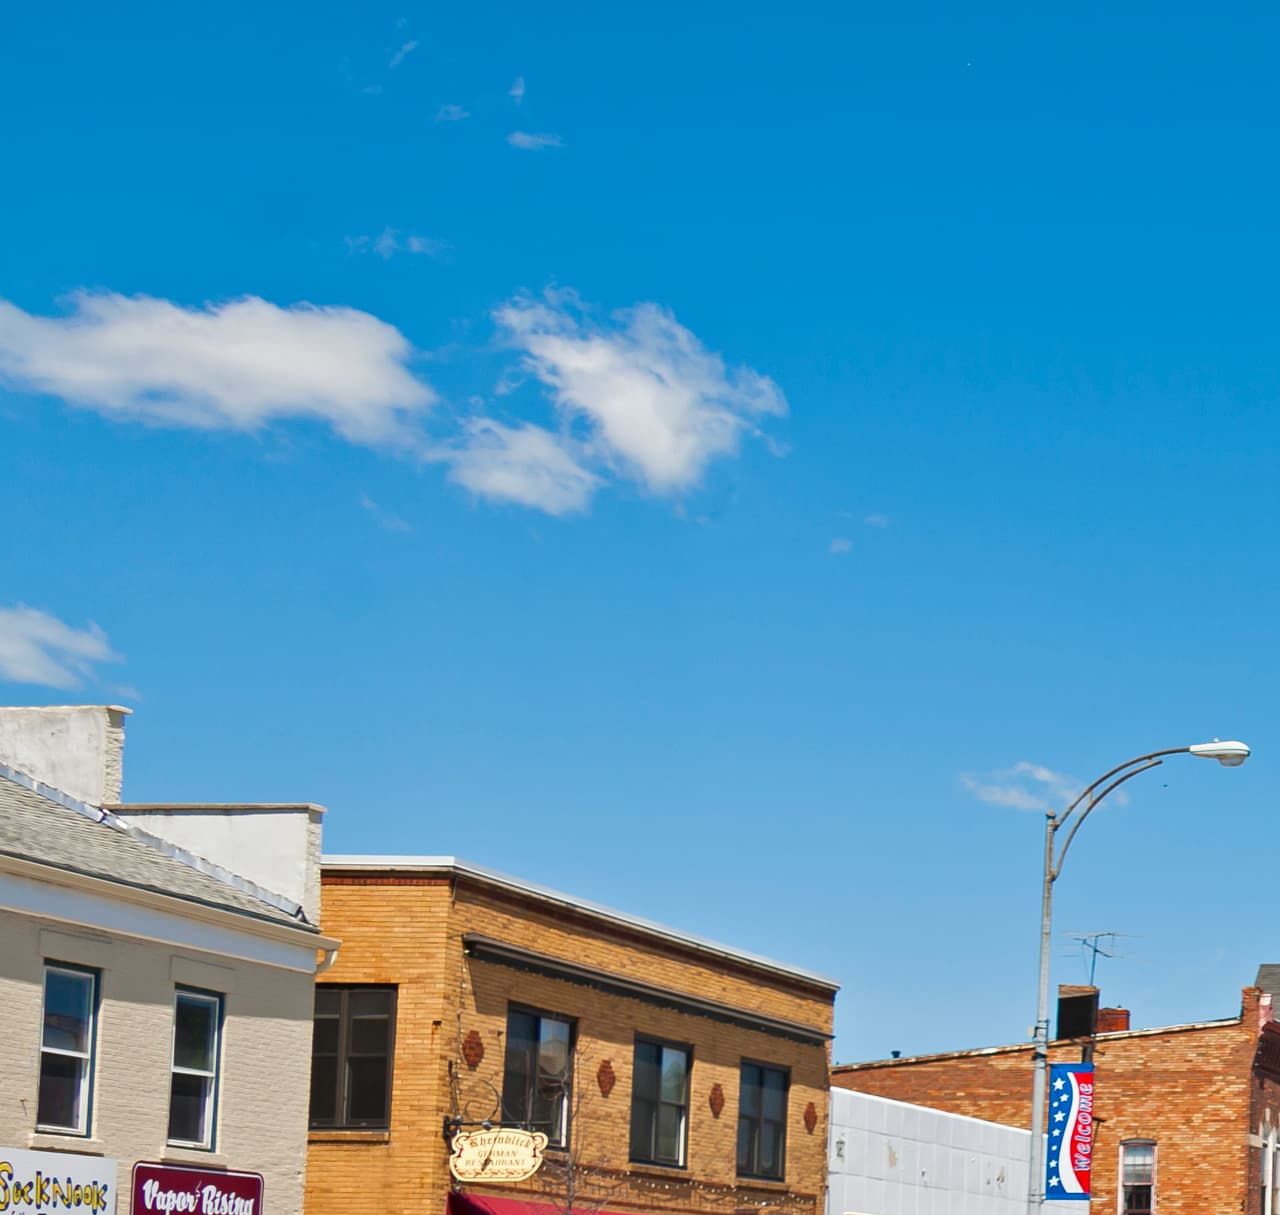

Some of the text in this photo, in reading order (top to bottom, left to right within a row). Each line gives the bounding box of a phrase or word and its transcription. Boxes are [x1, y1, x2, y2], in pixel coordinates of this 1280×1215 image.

[1074, 1082, 1093, 1172] Welcome
[0, 1161, 108, 1215] Sock Nook
[465, 1159, 525, 1167] RESAURANT
